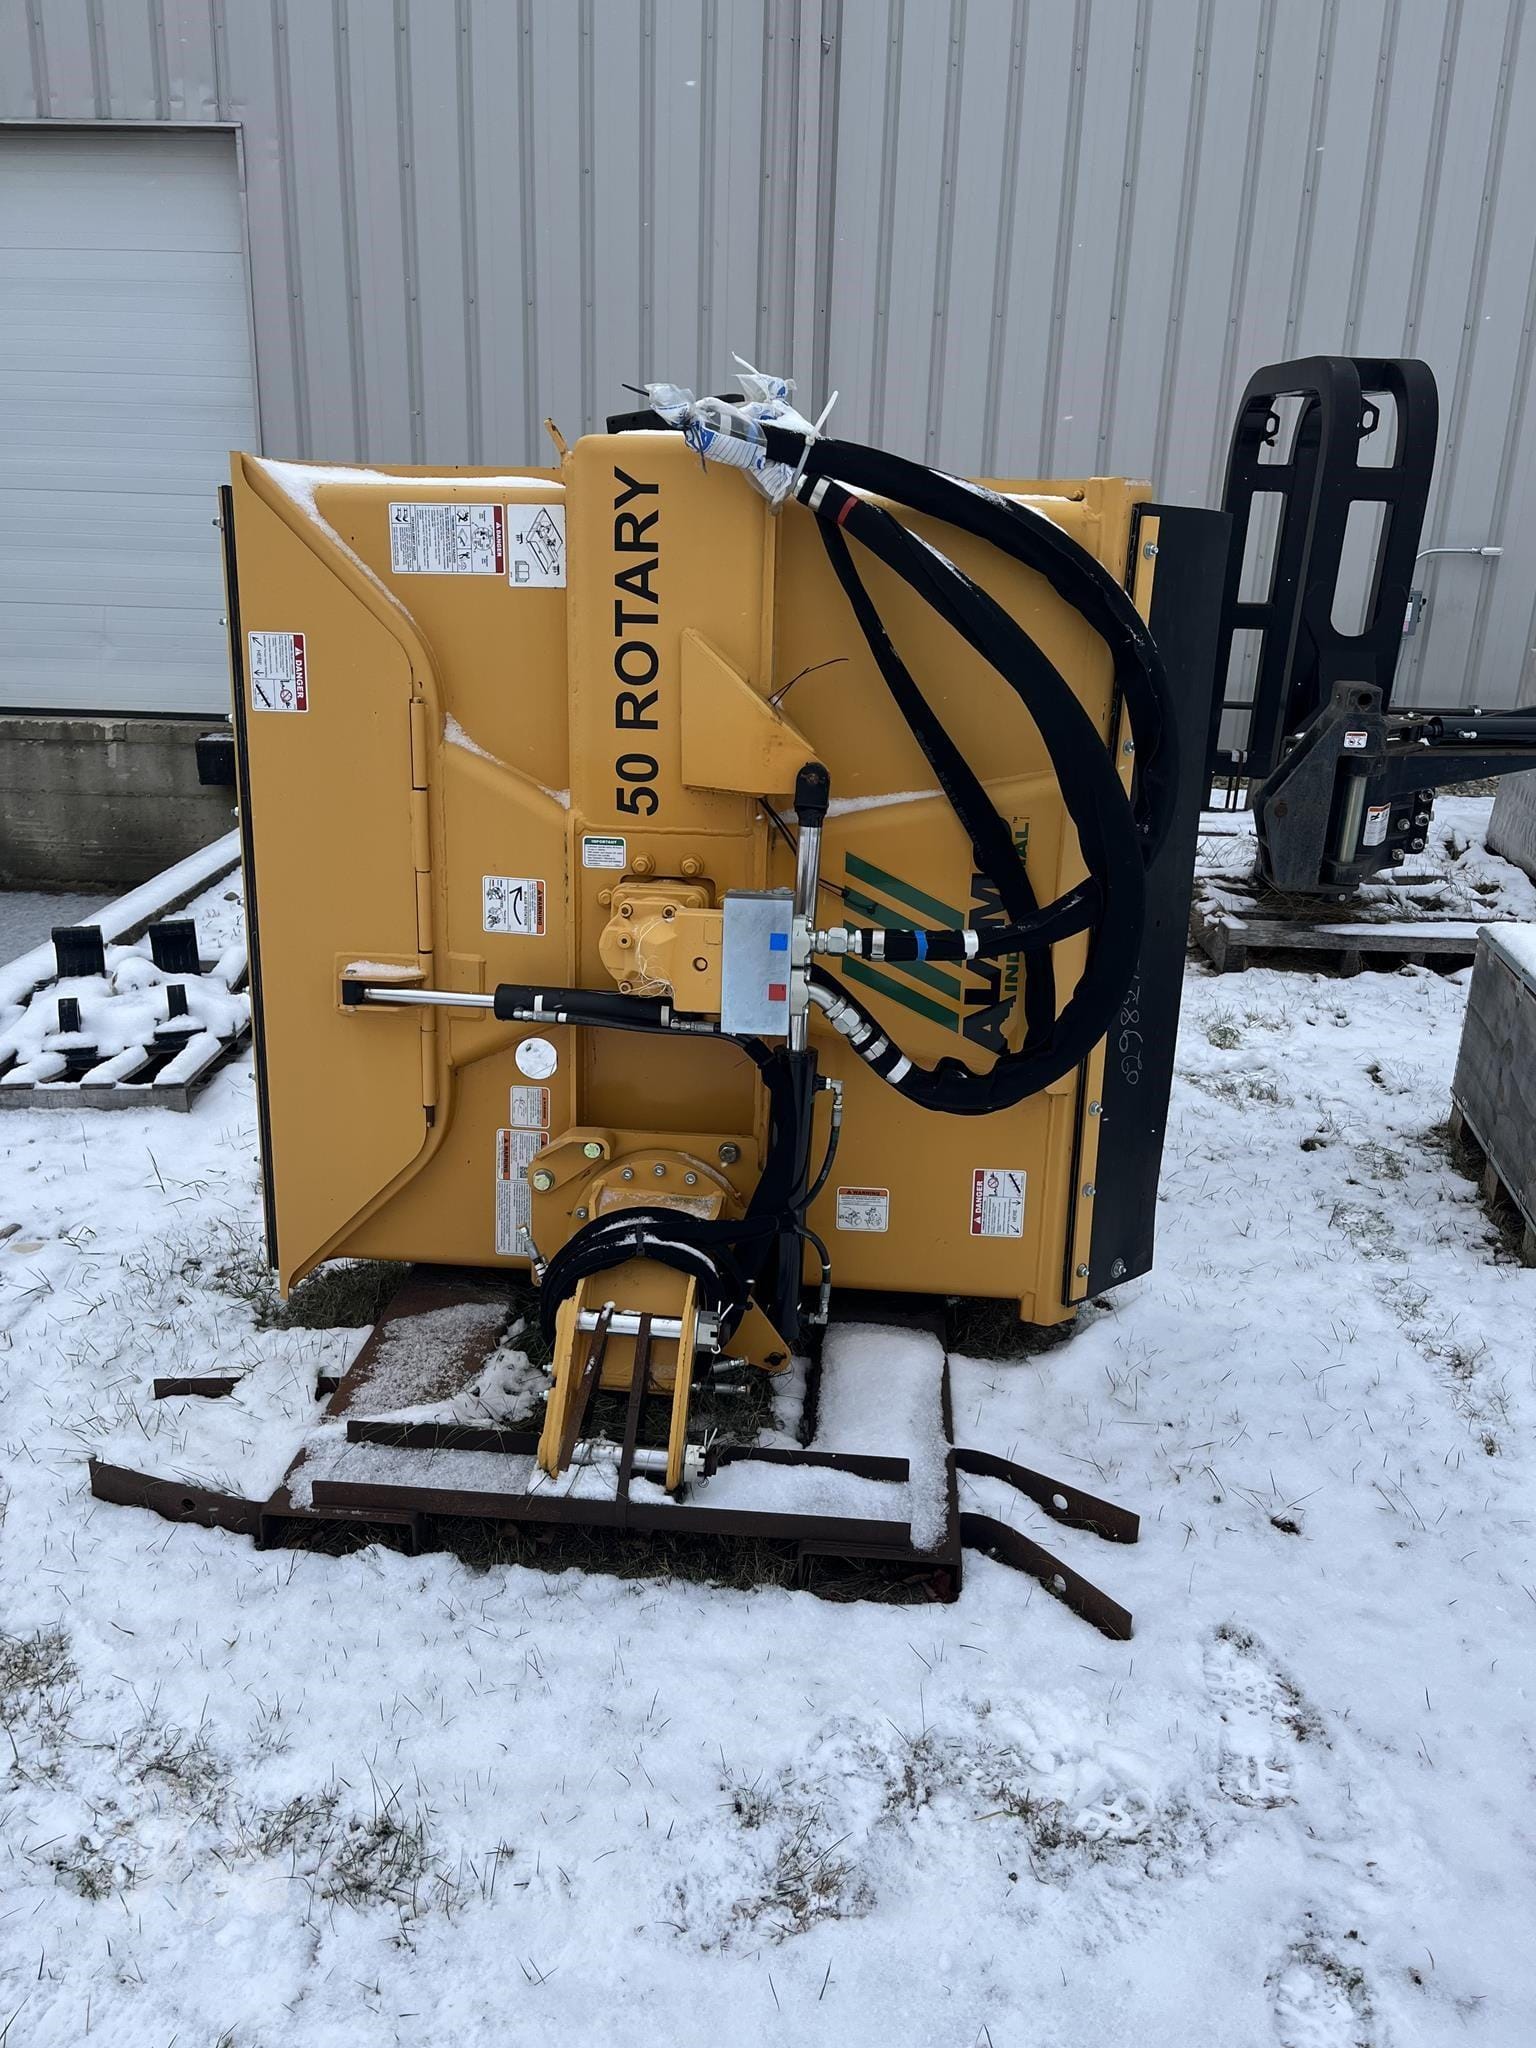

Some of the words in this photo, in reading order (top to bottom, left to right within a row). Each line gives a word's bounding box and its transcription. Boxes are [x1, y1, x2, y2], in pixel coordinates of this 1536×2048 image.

[614, 465, 659, 730] ROTARY
[295, 659, 304, 699] DANGER
[616, 753, 659, 817] 50
[975, 1180, 983, 1214] DANGER
